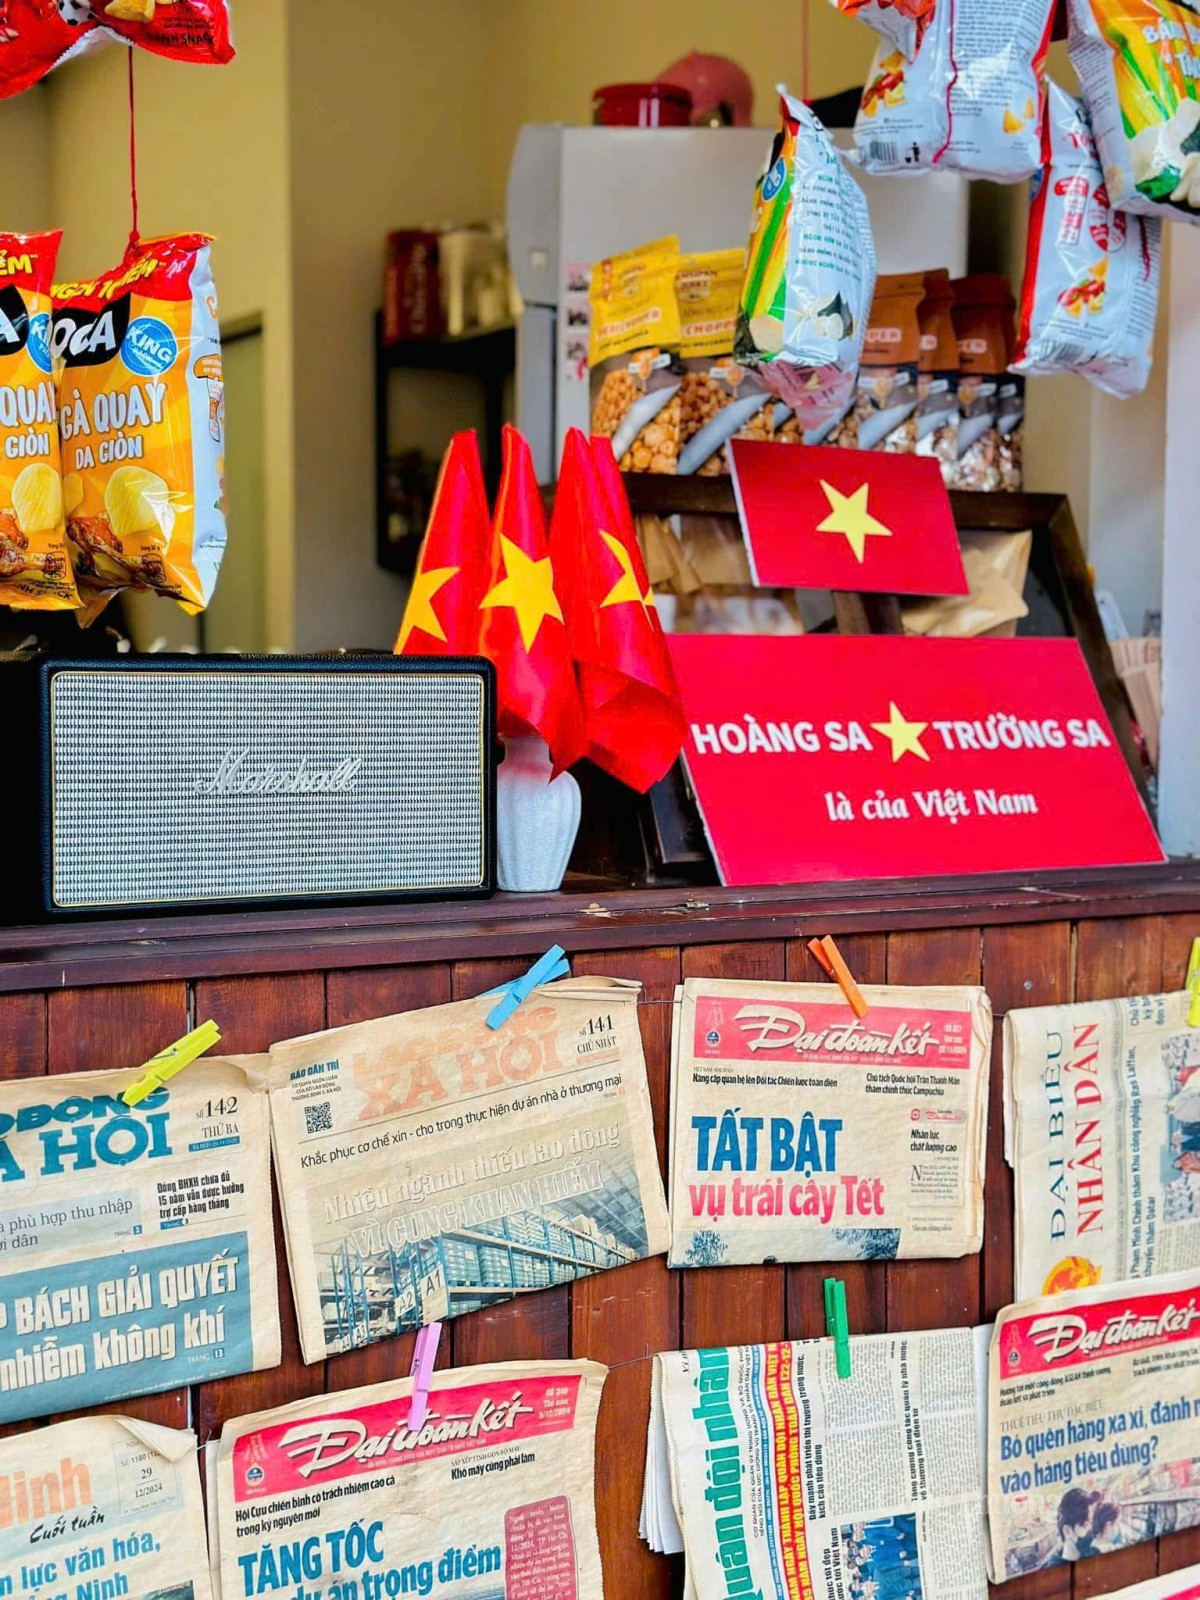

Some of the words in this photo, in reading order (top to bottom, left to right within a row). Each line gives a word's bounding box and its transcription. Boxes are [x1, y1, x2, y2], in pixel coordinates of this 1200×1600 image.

[126, 325, 173, 364] KING
[60, 388, 91, 441] GÀ
[94, 382, 167, 431] QUAY
[5, 427, 49, 459] GIÒN
[75, 446, 95, 471] DA
[99, 436, 143, 464] GIÒN
[691, 713, 820, 755] HOÀNG
[823, 720, 873, 752] SA
[932, 713, 1070, 750] TRƯỜNG
[1071, 718, 1112, 748] SA
[194, 749, 362, 794] Marshall
[824, 791, 852, 822] là
[862, 789, 909, 820] của
[912, 787, 970, 824] Việt
[975, 789, 1039, 816] Nam
[587, 1014, 614, 1035] 141
[734, 1004, 824, 1053] Đại
[824, 1022, 890, 1056] đoàn
[888, 1020, 940, 1057] Kết
[327, 1059, 339, 1071] TRÍ
[1063, 1022, 1103, 1107] DÂN
[1040, 1030, 1065, 1137] BIỂU
[1129, 1079, 1139, 1096] Ras
[205, 1096, 238, 1117] 142
[301, 1151, 327, 1168] Khắc
[329, 1146, 355, 1164] phục
[358, 1142, 370, 1153] cơ
[372, 1131, 390, 1149] chế
[392, 1129, 408, 1144] xin
[416, 1123, 434, 1138] cho
[436, 1115, 463, 1132] trong
[465, 1109, 488, 1126] thực
[489, 1102, 510, 1120] hiện
[512, 1100, 525, 1113] dự
[526, 1095, 539, 1108] án
[540, 1090, 558, 1106] nhà
[560, 1087, 568, 1099] ở
[604, 1074, 622, 1089] mại
[39, 1113, 173, 1176] HỘI
[202, 1122, 224, 1138] THỨ
[226, 1122, 239, 1135] BA
[691, 1107, 764, 1171] TẤT
[770, 1111, 843, 1178] BẬT
[532, 1139, 564, 1166] lao
[1130, 1154, 1140, 1172] Khu
[157, 1181, 177, 1193] Đóng
[179, 1176, 199, 1190] BHXH
[201, 1175, 219, 1186] chưa
[220, 1170, 230, 1182] đủ
[1067, 1119, 1104, 1236] NHÂN
[159, 1195, 167, 1205] 15
[170, 1192, 185, 1204] năm
[160, 1209, 171, 1220] trợ
[173, 1203, 187, 1217] cấp
[689, 1184, 725, 1222] vụ
[732, 1177, 784, 1216] trái
[789, 1179, 836, 1224] cây
[841, 1175, 885, 1216] Tết
[1048, 1158, 1069, 1241] ĐẠI
[1130, 1200, 1142, 1224] Chính
[10, 1212, 36, 1236] phù
[40, 1211, 67, 1228] hợp
[71, 1205, 95, 1221] thu
[100, 1198, 133, 1219] nhập
[11, 1233, 39, 1250] dân
[1131, 1226, 1141, 1247] Minh
[14, 1286, 90, 1336] BÁCH
[97, 1265, 152, 1318] GIẢI
[159, 1248, 239, 1309] QUYẾT
[424, 1270, 442, 1293] A1
[1, 1336, 87, 1392] nhiễm
[93, 1324, 176, 1370] không
[184, 1305, 225, 1349] khí
[766, 1378, 777, 1399] DÂN
[279, 1418, 391, 1478] Đại
[467, 1390, 535, 1433] Kết
[1000, 1434, 1022, 1461] Bỏ
[1025, 1426, 1065, 1458] quên
[1068, 1416, 1105, 1444] hàng
[1108, 1413, 1127, 1435] xa
[1151, 1396, 1191, 1425] đánh
[141, 1467, 152, 1479] 29
[704, 1445, 746, 1511] đội
[776, 1454, 787, 1482] QUÂN
[1000, 1470, 1031, 1495] vào
[1034, 1459, 1072, 1488] hàng
[1075, 1451, 1108, 1475] tiêu
[1110, 1435, 1159, 1467] dùng?
[135, 1482, 162, 1498] 12/2024
[371, 1478, 385, 1490] cao
[72, 1506, 105, 1531] tuần
[830, 1528, 839, 1547] Nam
[21, 1561, 57, 1592] lực
[65, 1547, 105, 1577] văn
[113, 1532, 161, 1561] hóa,
[238, 1534, 323, 1597] TĂNG
[326, 1518, 384, 1566] TỐC
[361, 1559, 434, 1600] trọng
[438, 1543, 501, 1584] điểm
[76, 1572, 128, 1600] Ninh
